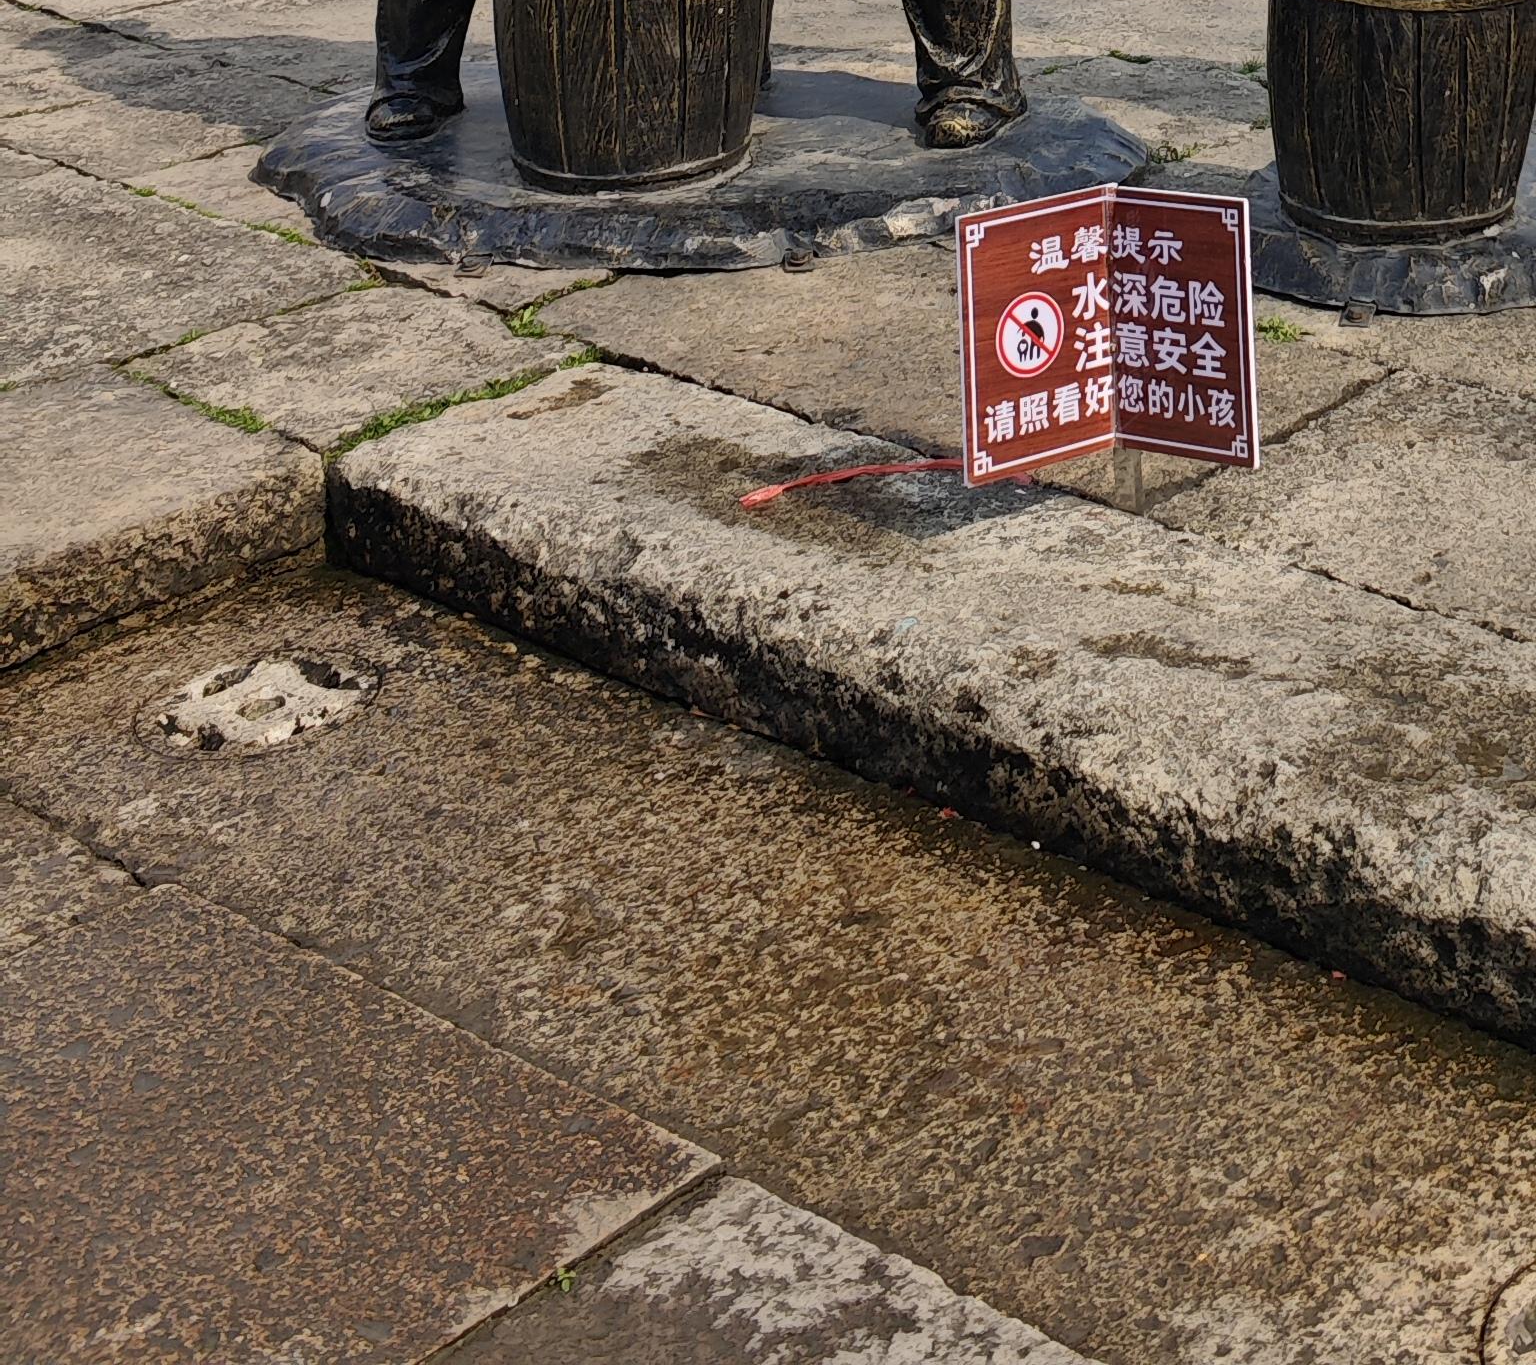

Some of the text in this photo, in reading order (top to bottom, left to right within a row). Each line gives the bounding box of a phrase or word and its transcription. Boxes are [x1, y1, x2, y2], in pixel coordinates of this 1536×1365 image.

[1029, 223, 1183, 275] 温馨提示
[1072, 271, 1225, 328] 水深危险
[1073, 322, 1228, 380] 注意安全
[984, 374, 1237, 444] 请照看好您的小孩
